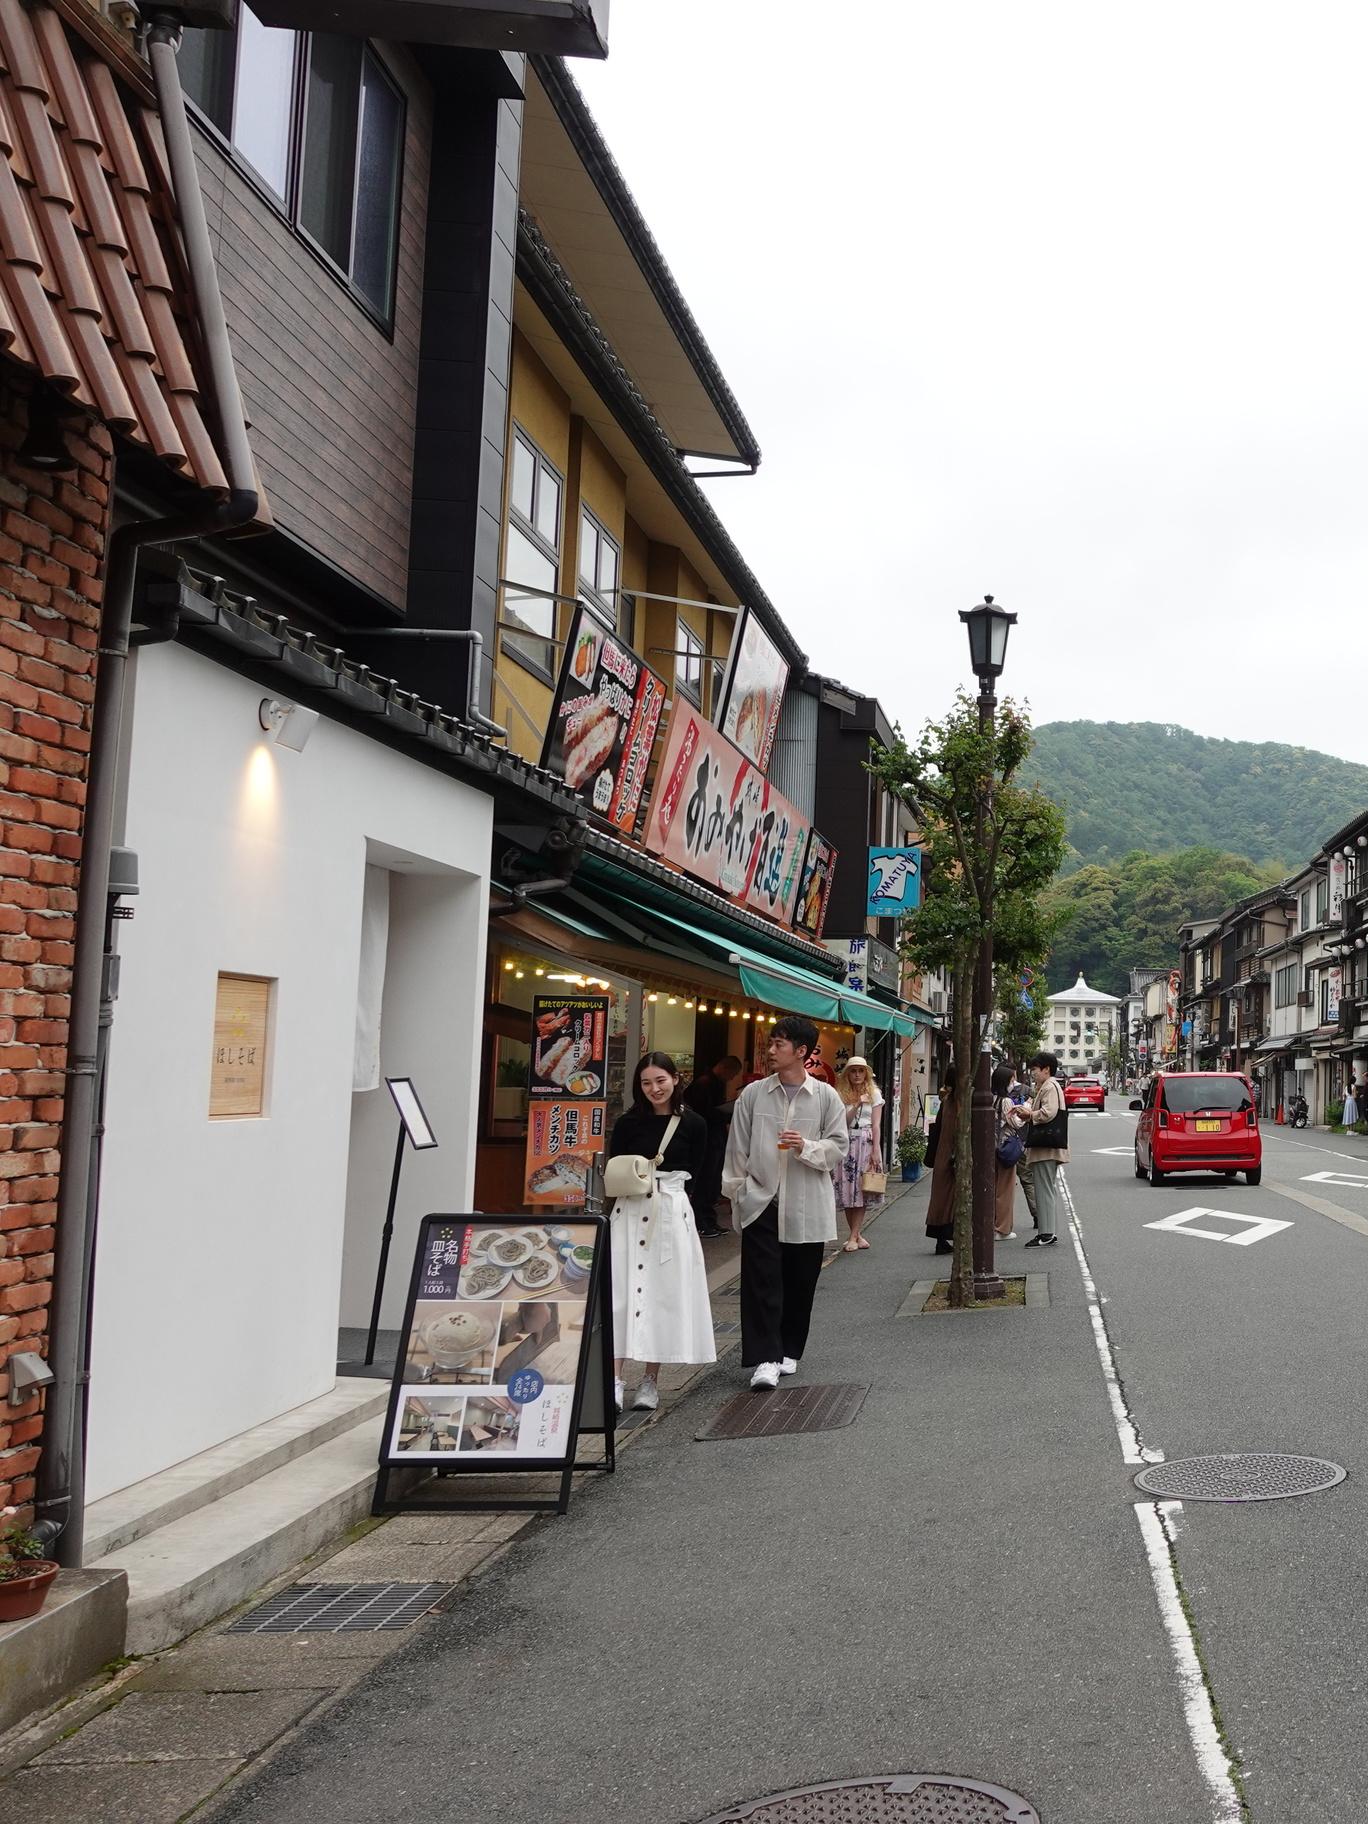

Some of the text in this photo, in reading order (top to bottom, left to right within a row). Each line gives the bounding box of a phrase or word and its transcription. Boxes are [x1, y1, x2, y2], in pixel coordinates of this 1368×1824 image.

[601, 639, 637, 690] 但馬に来たら
[616, 676, 655, 823] クリームコロッケ
[870, 852, 917, 905] KOMATUYA
[216, 1047, 256, 1065] ほしそば
[548, 1105, 560, 1154] メンチカツ
[564, 1110, 577, 1147] 但馬牛
[593, 1109, 602, 1134] 国産和牛
[427, 1241, 446, 1277] 皿そば
[443, 1240, 458, 1265] 名物
[522, 1375, 531, 1399] ゆったり
[537, 1400, 551, 1448] ほしそば
